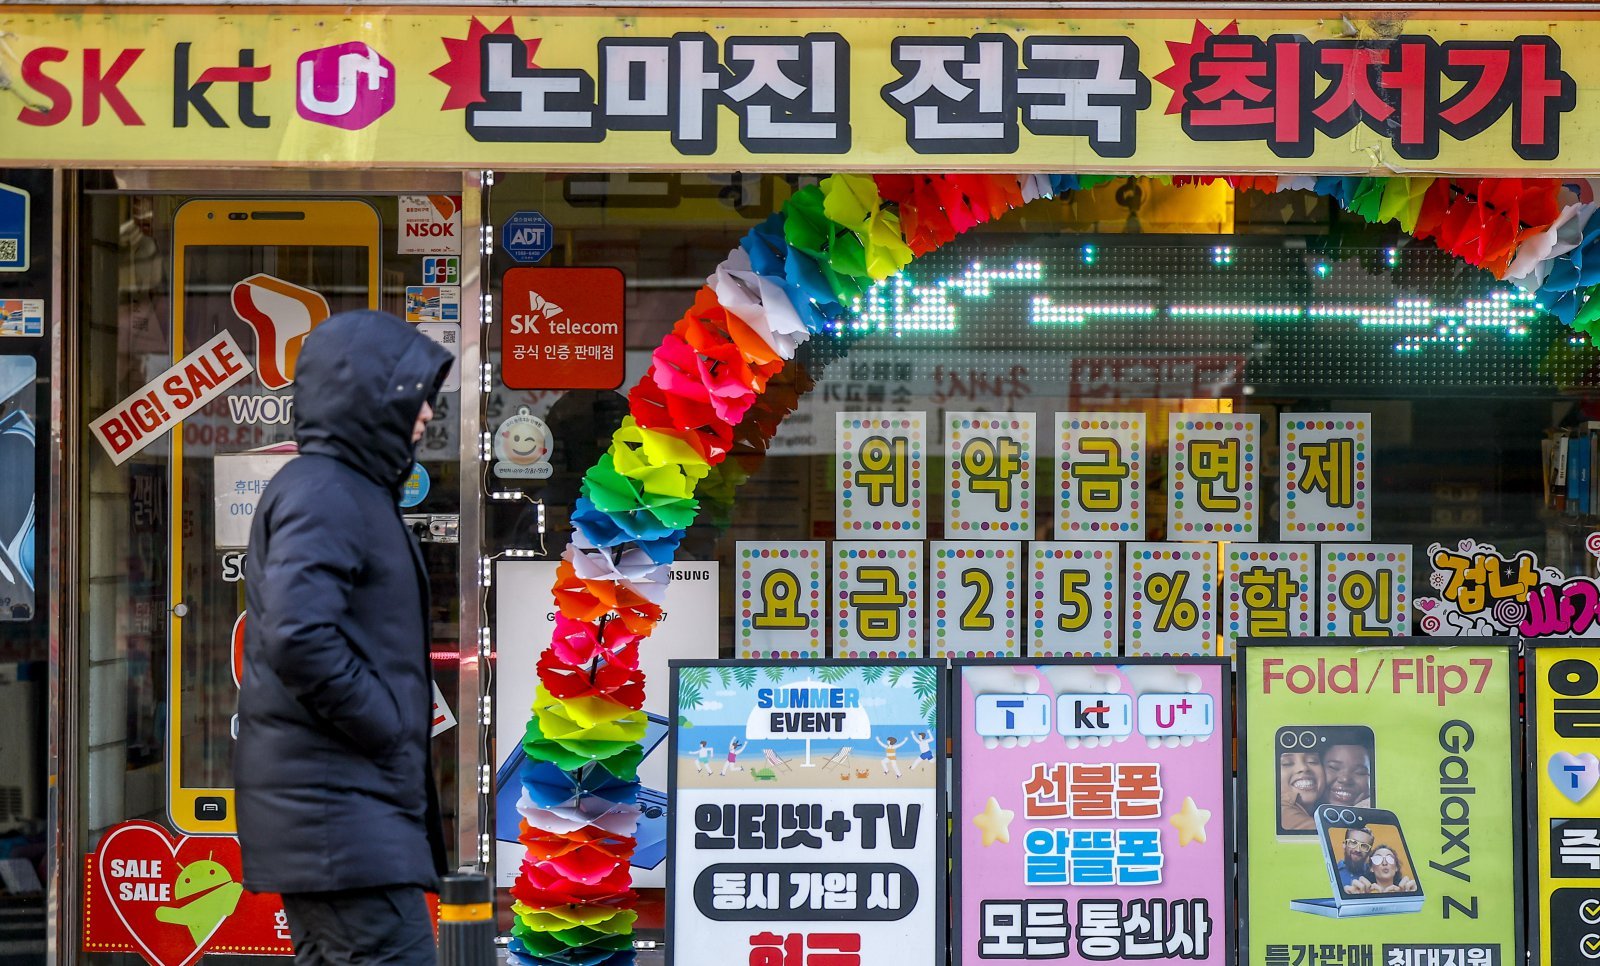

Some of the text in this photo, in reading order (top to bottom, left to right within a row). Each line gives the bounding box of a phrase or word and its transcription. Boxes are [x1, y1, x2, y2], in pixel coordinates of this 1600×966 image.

[17, 42, 389, 128] SK kt U+
[466, 33, 1576, 160] 노마진 전국 최저가
[406, 222, 454, 237] NSOK
[510, 228, 545, 246] ADT
[424, 266, 457, 276] JCB
[510, 314, 618, 335] SK telecom
[512, 345, 614, 360] 공식 인증 판매점
[99, 340, 243, 455] BIG! SALE
[1433, 551, 1540, 614] 겁나
[758, 688, 860, 709] SUMMER
[1262, 658, 1359, 694] Fold
[1392, 655, 1493, 706] Flip7
[770, 712, 847, 733] EVENT
[1074, 700, 1110, 729] kt
[1155, 698, 1193, 729] U+
[1023, 763, 1163, 819] 선불폰
[694, 803, 922, 850] 인터넷+TV
[1429, 719, 1479, 920] Galaxy Z
[111, 859, 162, 878] SALE
[1023, 828, 1163, 885] 알뜰폰
[119, 882, 171, 901] SALE
[713, 872, 901, 910] 동시 가입 시
[979, 899, 1212, 959] 모든 통신사
